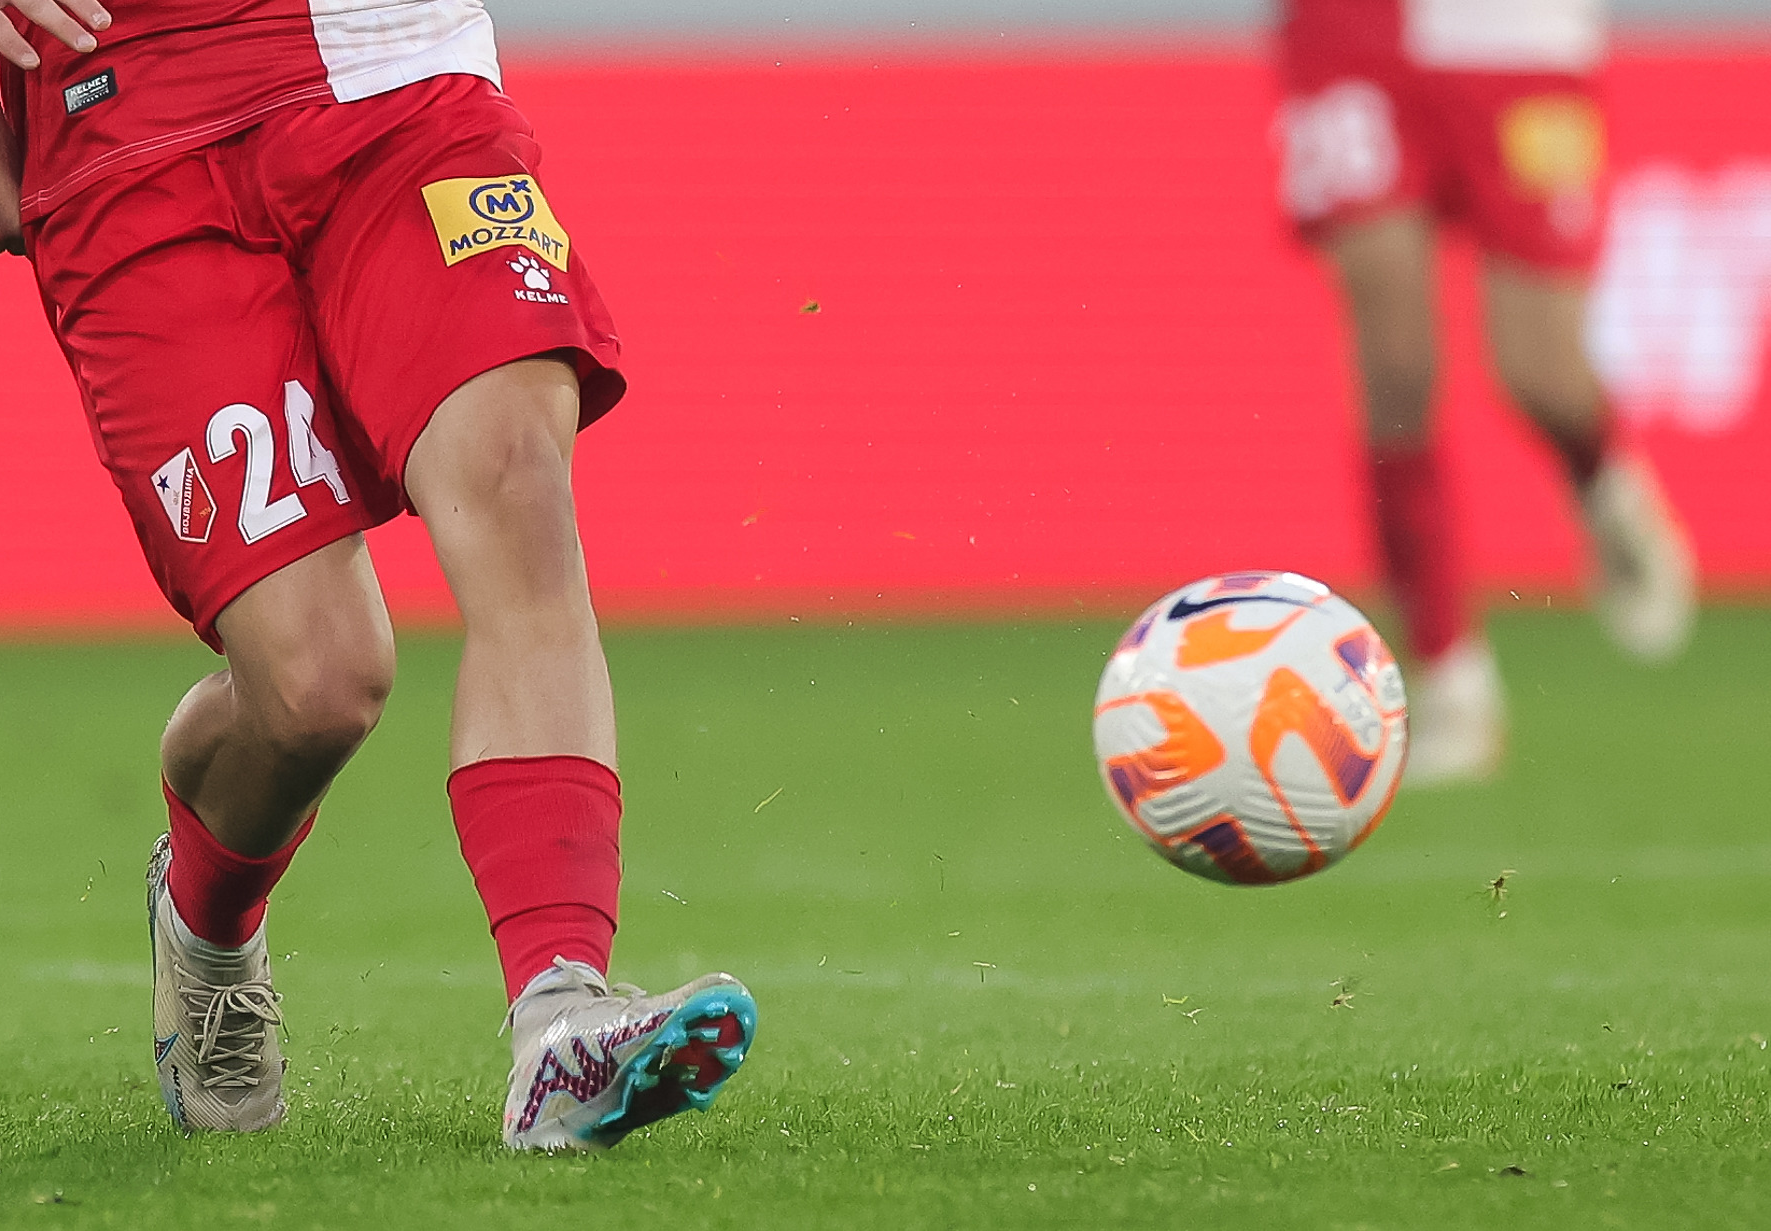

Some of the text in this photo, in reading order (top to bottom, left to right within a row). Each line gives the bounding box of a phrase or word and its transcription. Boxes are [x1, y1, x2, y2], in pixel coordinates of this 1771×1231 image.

[449, 226, 564, 260] MOZZART
[514, 289, 569, 305] KELME
[205, 379, 351, 546] 24
